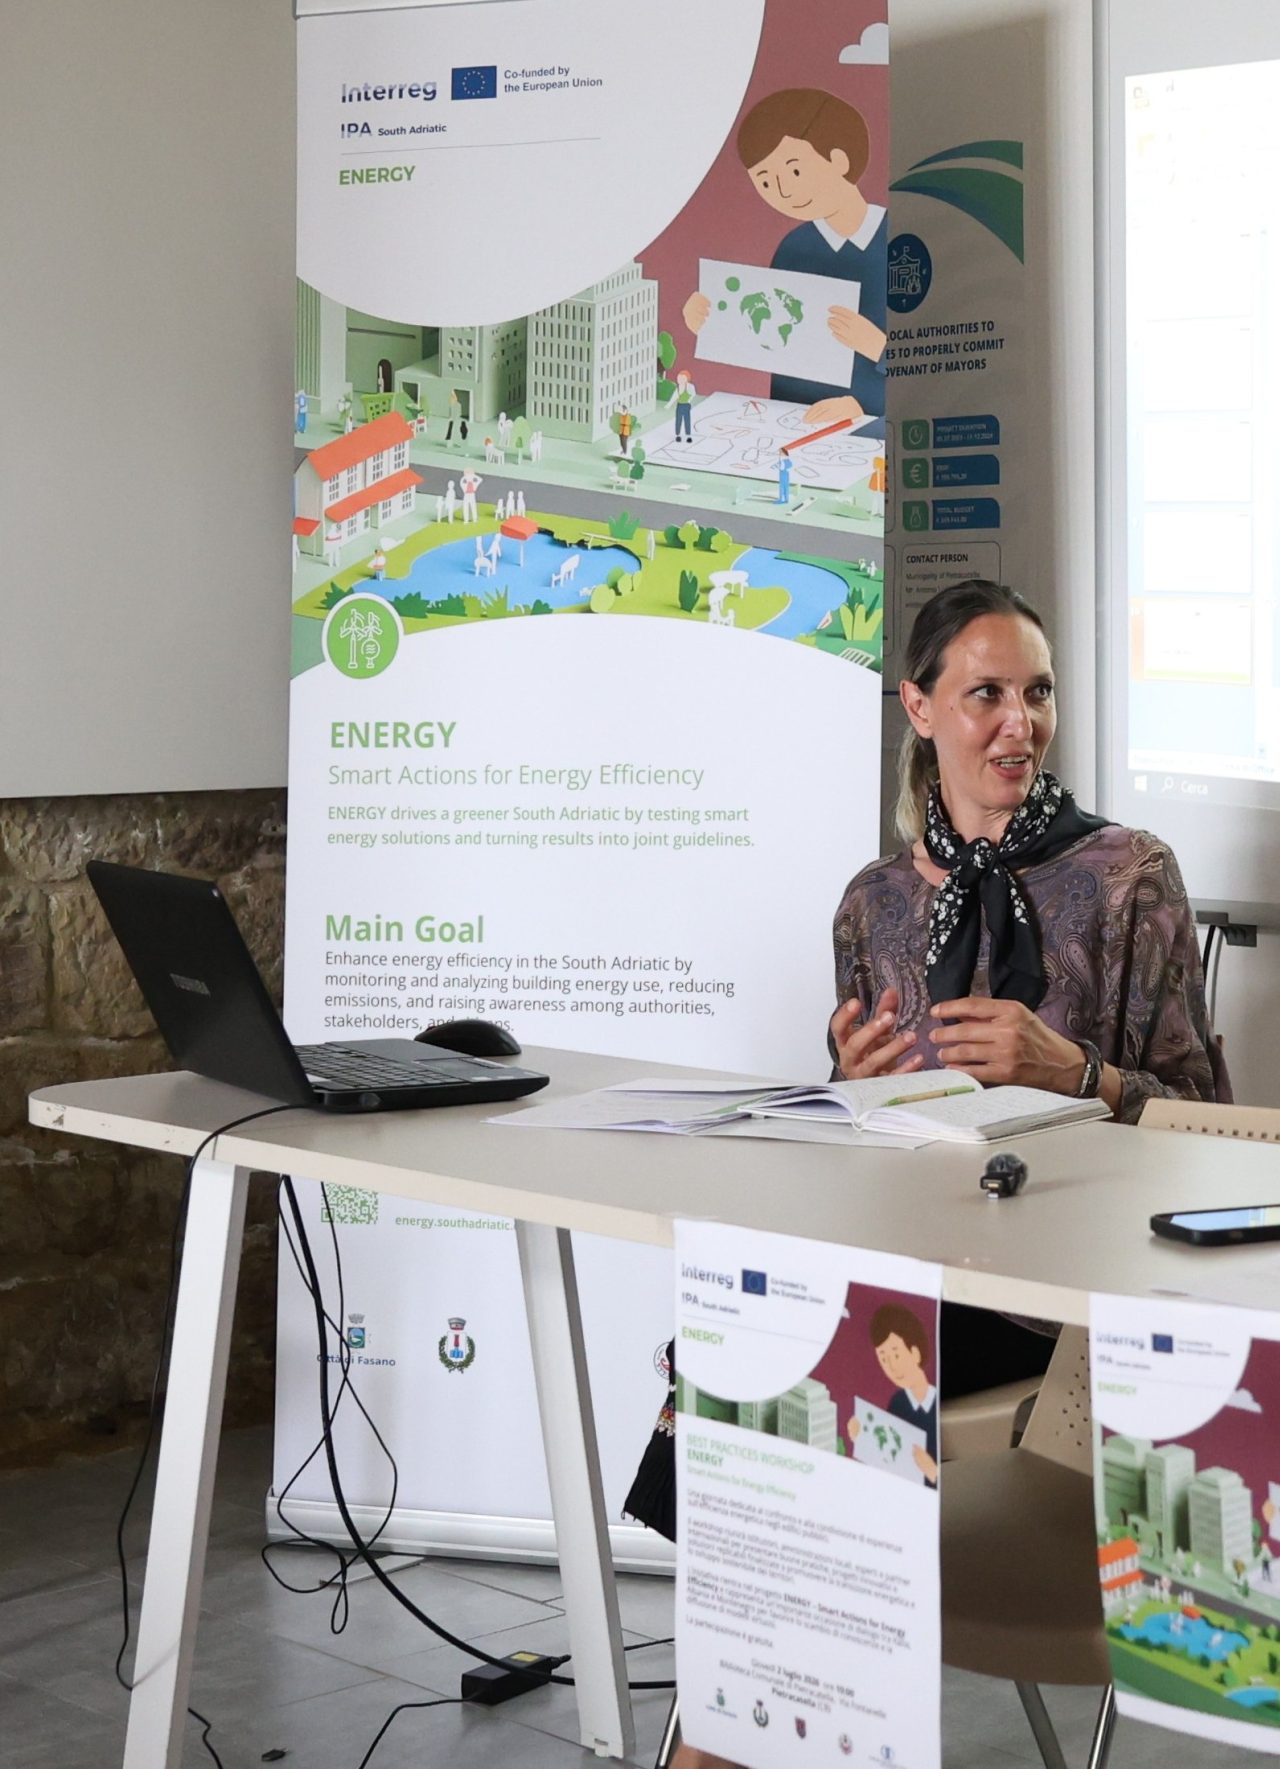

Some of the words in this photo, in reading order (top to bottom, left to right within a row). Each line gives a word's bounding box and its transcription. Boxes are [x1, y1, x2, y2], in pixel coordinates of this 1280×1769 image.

[504, 66, 555, 79] Co-funded
[558, 66, 569, 76] by
[341, 81, 437, 103] Interreg
[504, 83, 520, 92] the
[522, 78, 569, 92] European
[572, 77, 602, 87] Union
[341, 123, 372, 139] IPA
[378, 126, 406, 136] South
[409, 124, 446, 134] Adriatic
[339, 165, 415, 185] ENERGY
[886, 330, 914, 341] OCAL
[916, 322, 978, 338] AUTHORITIES
[981, 320, 994, 332] TO
[898, 347, 910, 358] TO
[913, 342, 960, 356] PROPERLY
[963, 338, 1004, 352] COMMIT
[930, 362, 942, 373] OF
[945, 358, 986, 372] MAYORS
[906, 554, 938, 563] CONTACT
[940, 554, 968, 562] PERSON
[331, 721, 456, 748] ENERGY
[329, 765, 392, 784] Smart
[398, 765, 476, 785] Actions
[484, 764, 512, 784] for
[520, 765, 592, 790] Energy
[600, 763, 704, 790] Efficiency
[1181, 780, 1209, 796] Cerca
[328, 806, 386, 820] ENERGY
[390, 805, 436, 820] drives
[440, 809, 449, 820] a
[453, 809, 509, 824] greener
[513, 806, 555, 820] South
[559, 806, 620, 821] Adriatic
[624, 806, 643, 824] by
[648, 807, 700, 825] testing
[704, 808, 748, 821] smart
[327, 833, 377, 848] energy
[381, 830, 450, 844] solutions
[454, 831, 481, 845] and
[486, 831, 538, 849] turning
[542, 831, 593, 845] results
[598, 831, 629, 846] into
[632, 832, 669, 849] joint
[672, 831, 754, 850] guidelines.
[326, 914, 403, 941] Main
[415, 915, 483, 943] Goal
[326, 951, 387, 966] Enhance
[392, 955, 442, 970] energy
[447, 952, 512, 972] efficiency
[516, 955, 528, 968] in
[534, 954, 557, 969] the
[562, 955, 606, 969] South
[611, 956, 669, 971] Adriatic
[675, 956, 692, 975] by
[325, 973, 406, 991] monitoring
[410, 973, 438, 987] and
[443, 974, 508, 993] analyzing
[512, 975, 570, 994] building
[575, 980, 628, 995] energy
[633, 981, 663, 994] use,
[669, 978, 734, 997] reducing
[324, 993, 400, 1009] emissions,
[406, 994, 433, 1008] and
[439, 995, 485, 1013] raising
[489, 999, 566, 1011] awareness
[570, 1001, 624, 1016] among
[628, 999, 714, 1016] authorities,
[324, 1014, 423, 1032] stakeholders,
[681, 1263, 734, 1289] Interreg
[682, 1292, 699, 1306] IPA
[682, 1326, 724, 1346] ENERGY
[317, 1353, 341, 1364] Cttà
[358, 1356, 396, 1367] Fasano
[687, 1450, 724, 1468] ENERGY
